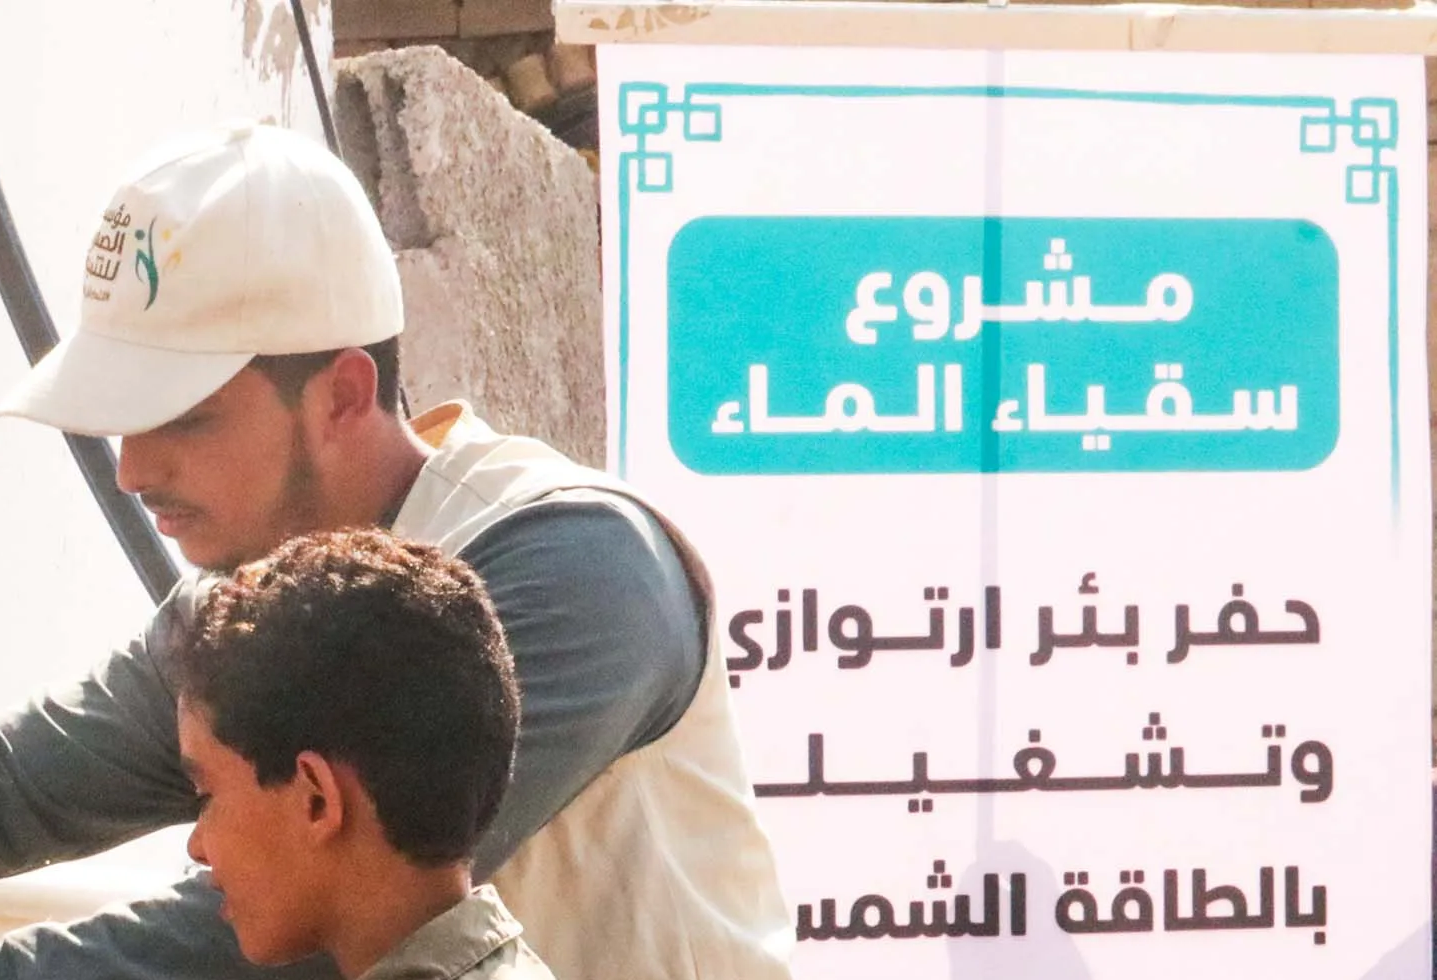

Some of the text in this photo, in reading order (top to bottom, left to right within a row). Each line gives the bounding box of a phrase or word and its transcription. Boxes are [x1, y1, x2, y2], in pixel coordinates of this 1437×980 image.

[845, 238, 1192, 344] مشروع
[711, 363, 1298, 452] سقياء الماء
[726, 571, 1321, 688] حفر بئر ارتوازي
[752, 712, 1334, 814] وتشغيل
[796, 859, 1326, 946] بالطاقة الشمس
